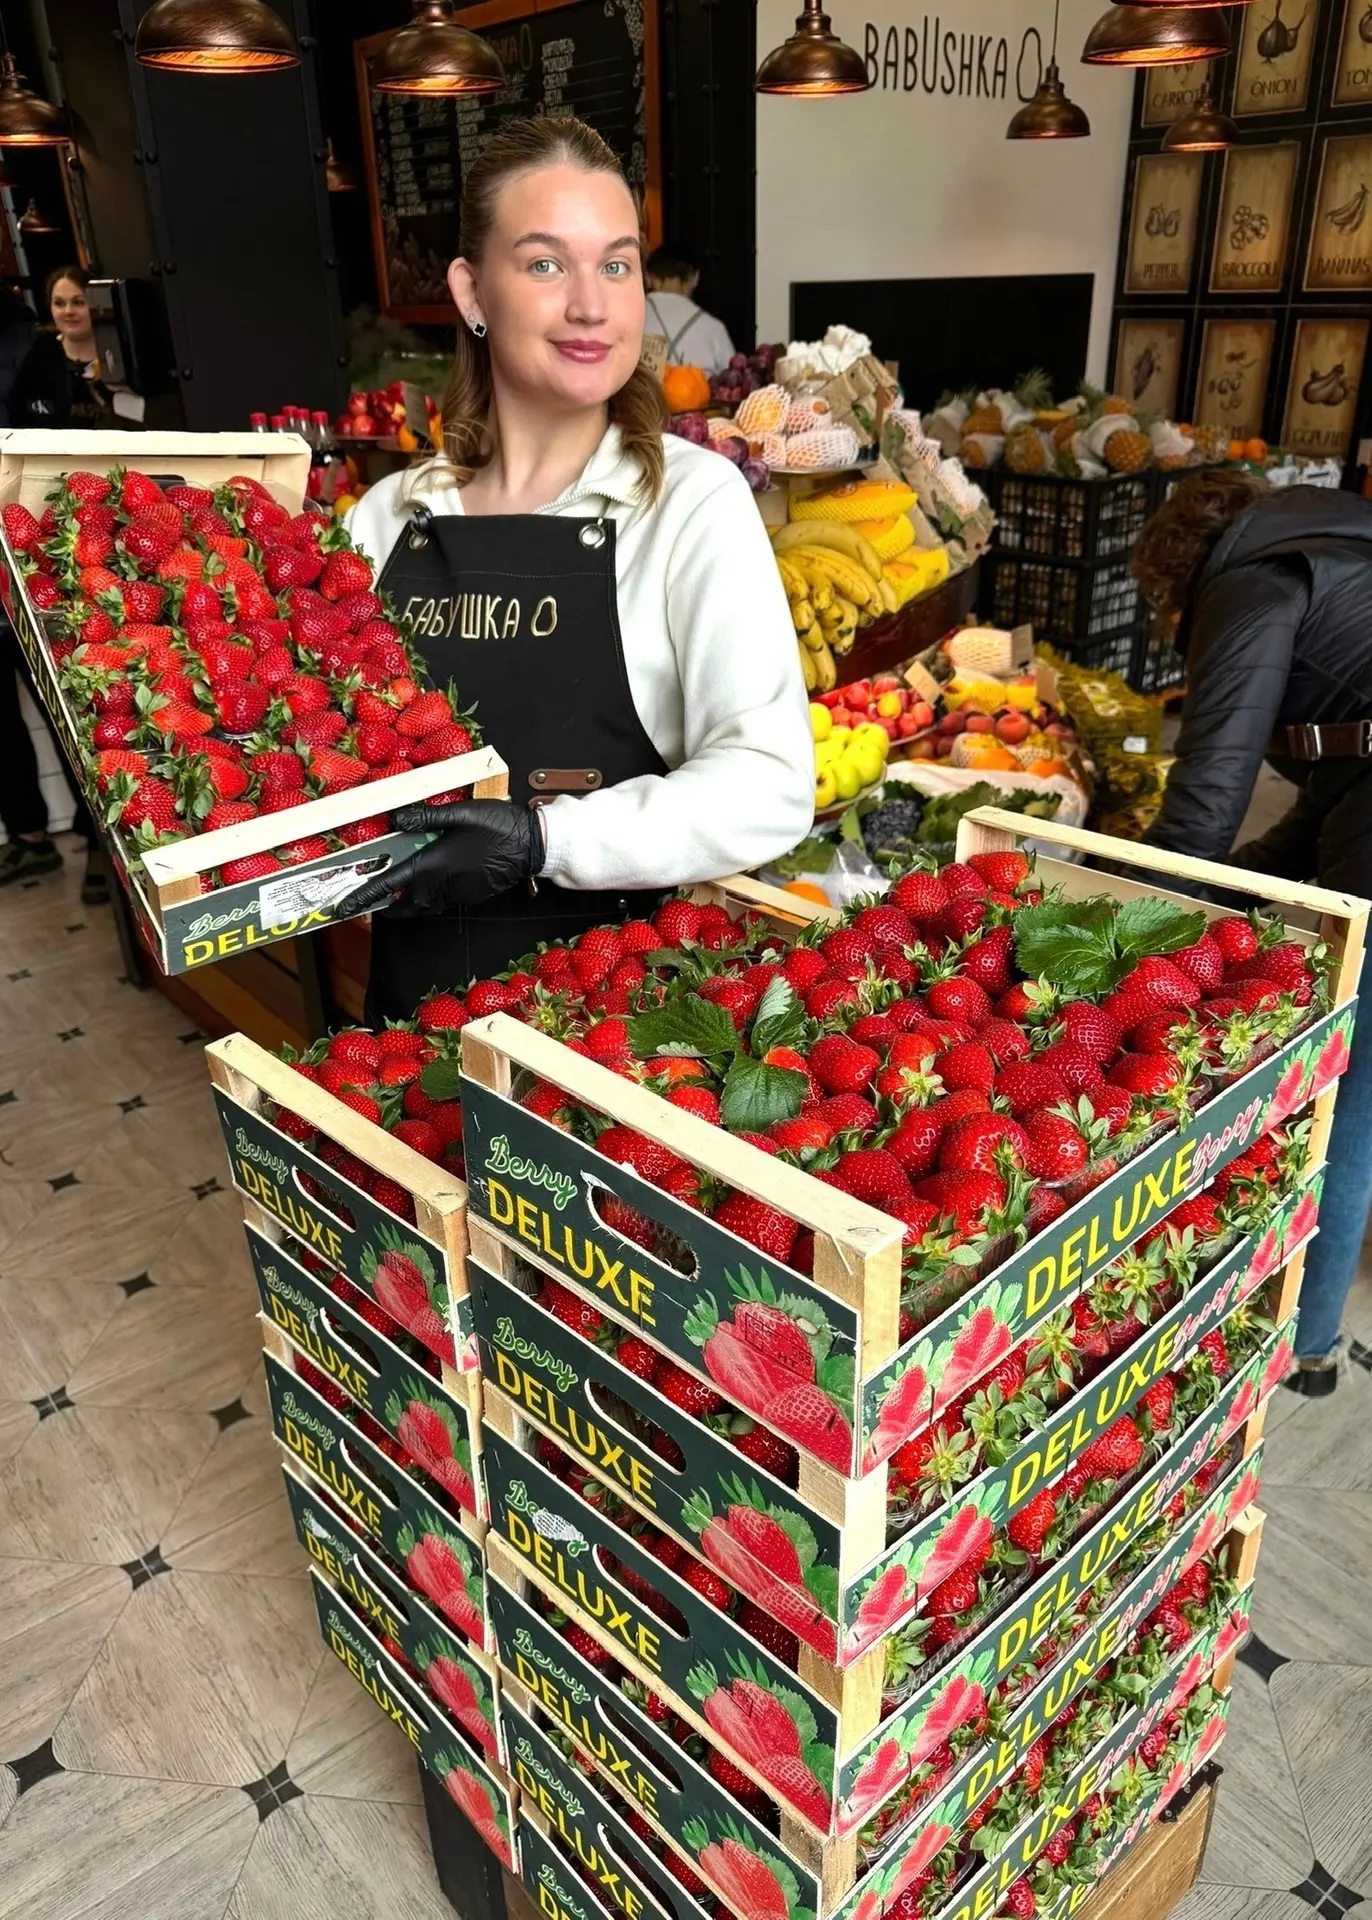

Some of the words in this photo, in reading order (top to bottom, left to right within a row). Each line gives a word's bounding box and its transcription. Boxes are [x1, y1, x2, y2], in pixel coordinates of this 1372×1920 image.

[865, 15, 1007, 99] BABUSHKA
[1251, 77, 1298, 98] ONION
[401, 593, 520, 640] БАБУШКА
[236, 1127, 288, 1184] Berry
[485, 1134, 578, 1211] Berry
[1183, 1096, 1263, 1192] Berry
[240, 1158, 347, 1270] DELUXE
[487, 1176, 657, 1328] DELUXE
[1025, 1138, 1198, 1321] DELUXE
[263, 1265, 318, 1326] Berry
[1164, 1270, 1239, 1367] Berry
[271, 1292, 374, 1410] DELUXE
[493, 1317, 579, 1393] Berry
[282, 1392, 336, 1450] Berry
[496, 1351, 657, 1509] DELUXE
[1008, 1321, 1180, 1509] DELUXE
[284, 1417, 382, 1537] DELUXE
[505, 1479, 589, 1557] Bey
[305, 1529, 402, 1647] DELUXE
[507, 1509, 662, 1672] DELUXE
[997, 1478, 1160, 1673] DELUXE
[330, 1629, 422, 1753] DELUXE
[512, 1627, 591, 1704] Berry
[966, 1615, 1121, 1810] DELUXE
[515, 1737, 585, 1817] Berry
[516, 1653, 661, 1819] DELUXE
